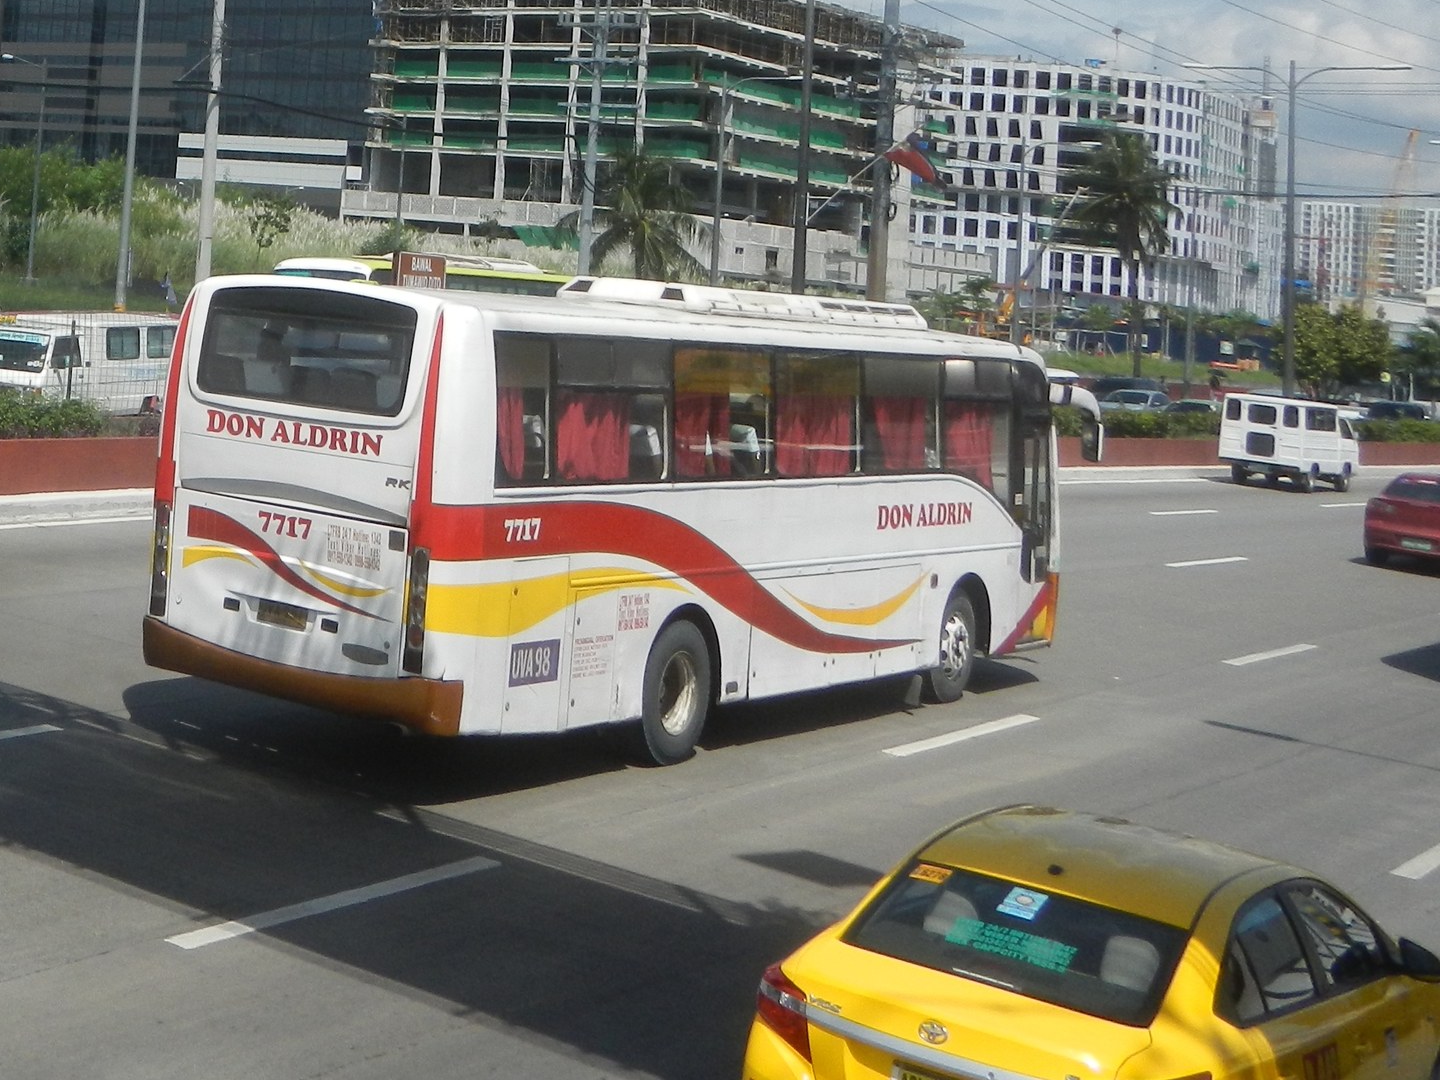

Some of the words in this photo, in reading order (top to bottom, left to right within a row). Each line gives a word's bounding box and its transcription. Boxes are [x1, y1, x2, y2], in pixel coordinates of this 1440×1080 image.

[411, 256, 432, 272] BAWAL
[206, 409, 265, 439] DON
[270, 420, 383, 457] ALDRIN
[384, 477, 411, 490] RK
[258, 510, 312, 540] 7717
[504, 518, 542, 542] 7717
[877, 504, 913, 530] DON
[916, 502, 972, 527] ALDRIN
[512, 648, 533, 680] UVA
[535, 646, 551, 677] 98
